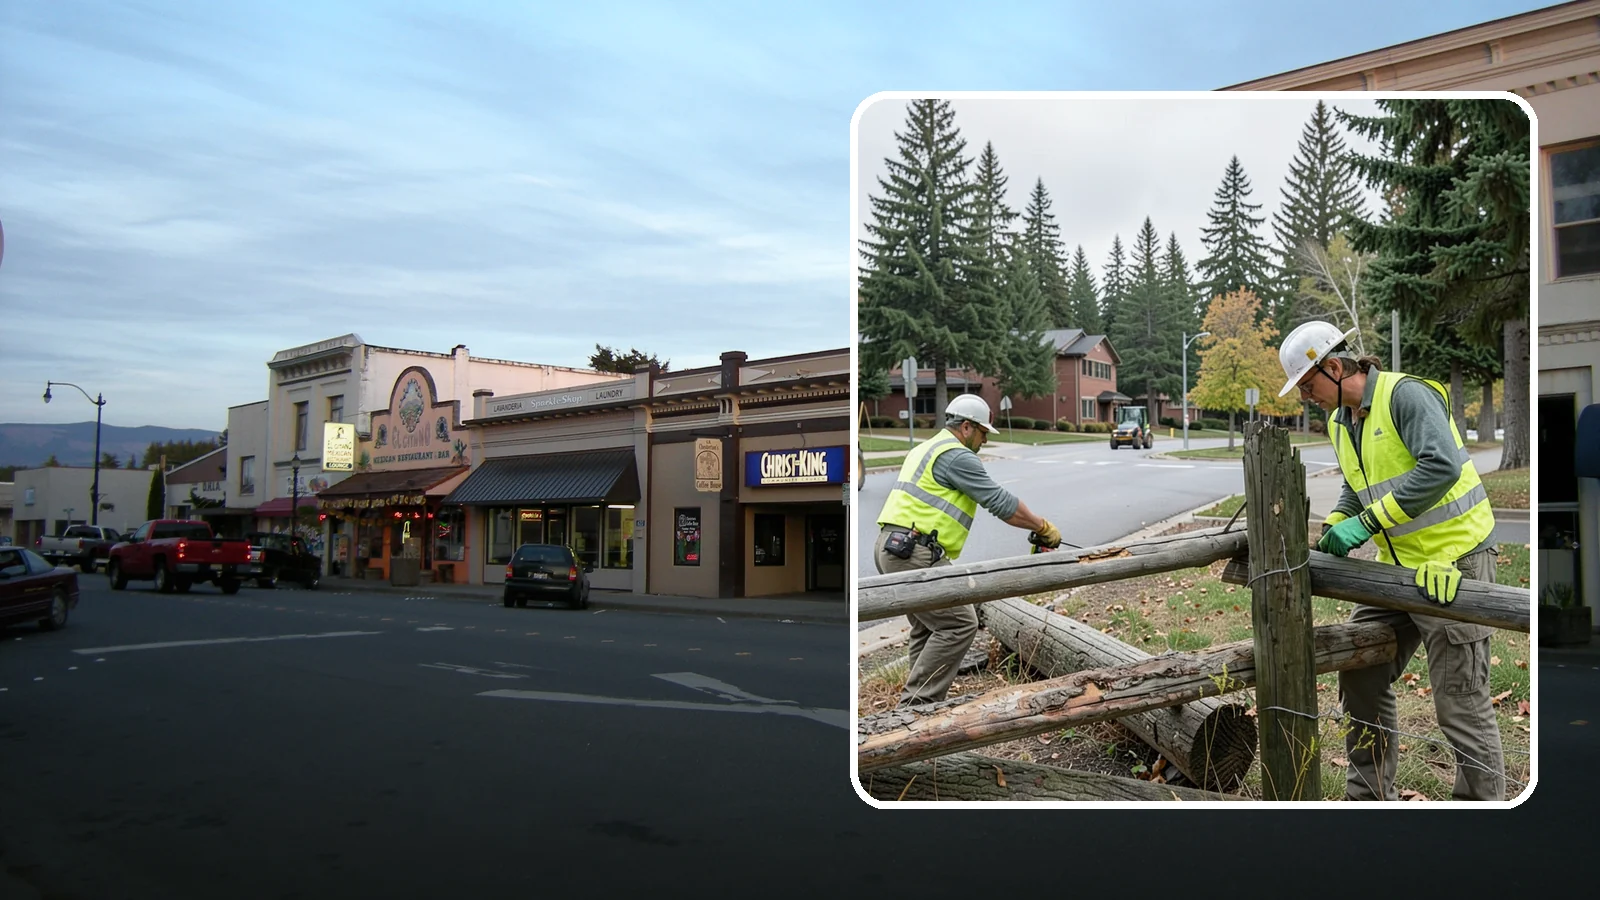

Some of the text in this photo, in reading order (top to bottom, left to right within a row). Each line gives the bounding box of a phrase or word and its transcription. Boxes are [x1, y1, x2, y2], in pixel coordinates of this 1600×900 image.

[493, 389, 623, 412] LAVANDERIA Sparkle Shop LAUNDRY
[373, 455, 396, 464] MEXICAN
[398, 452, 434, 462] RESTAURANT
[438, 450, 450, 459] BAR
